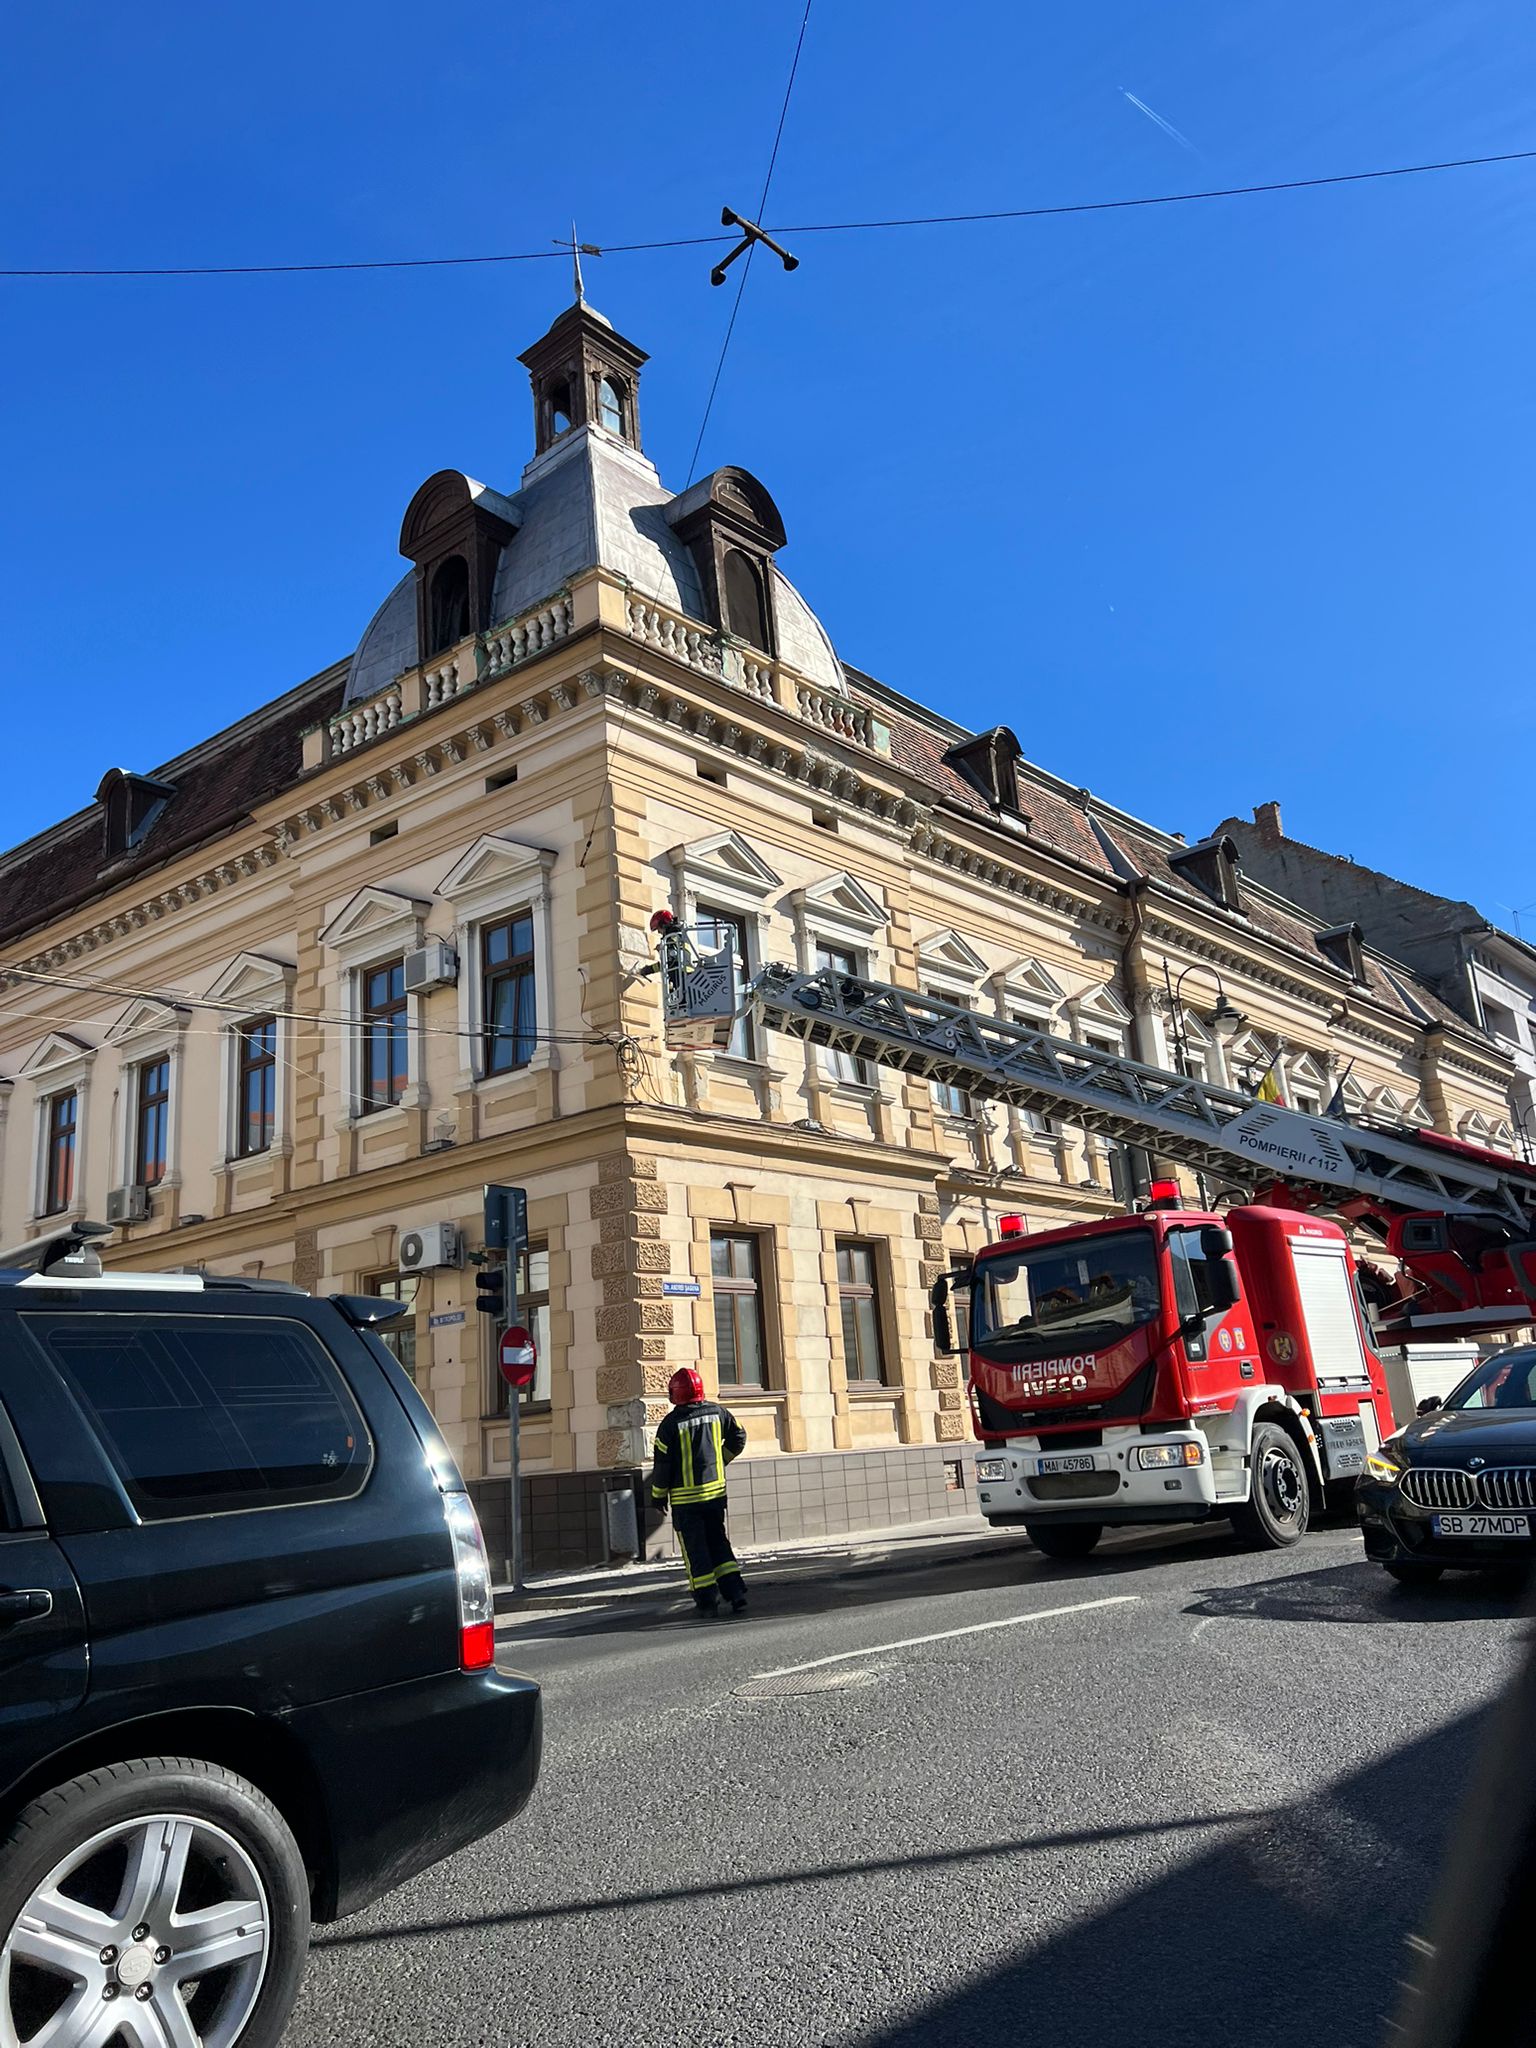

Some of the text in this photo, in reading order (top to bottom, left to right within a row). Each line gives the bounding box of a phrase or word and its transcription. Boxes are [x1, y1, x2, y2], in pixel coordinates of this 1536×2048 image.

[698, 974, 726, 1006] MAGIRUS
[1240, 1135, 1338, 1173] POMPIERII 112
[1023, 1375, 1087, 1397] IVECO
[1044, 1458, 1091, 1472] MAI 45786
[1440, 1517, 1527, 1534] SB 27MDP
